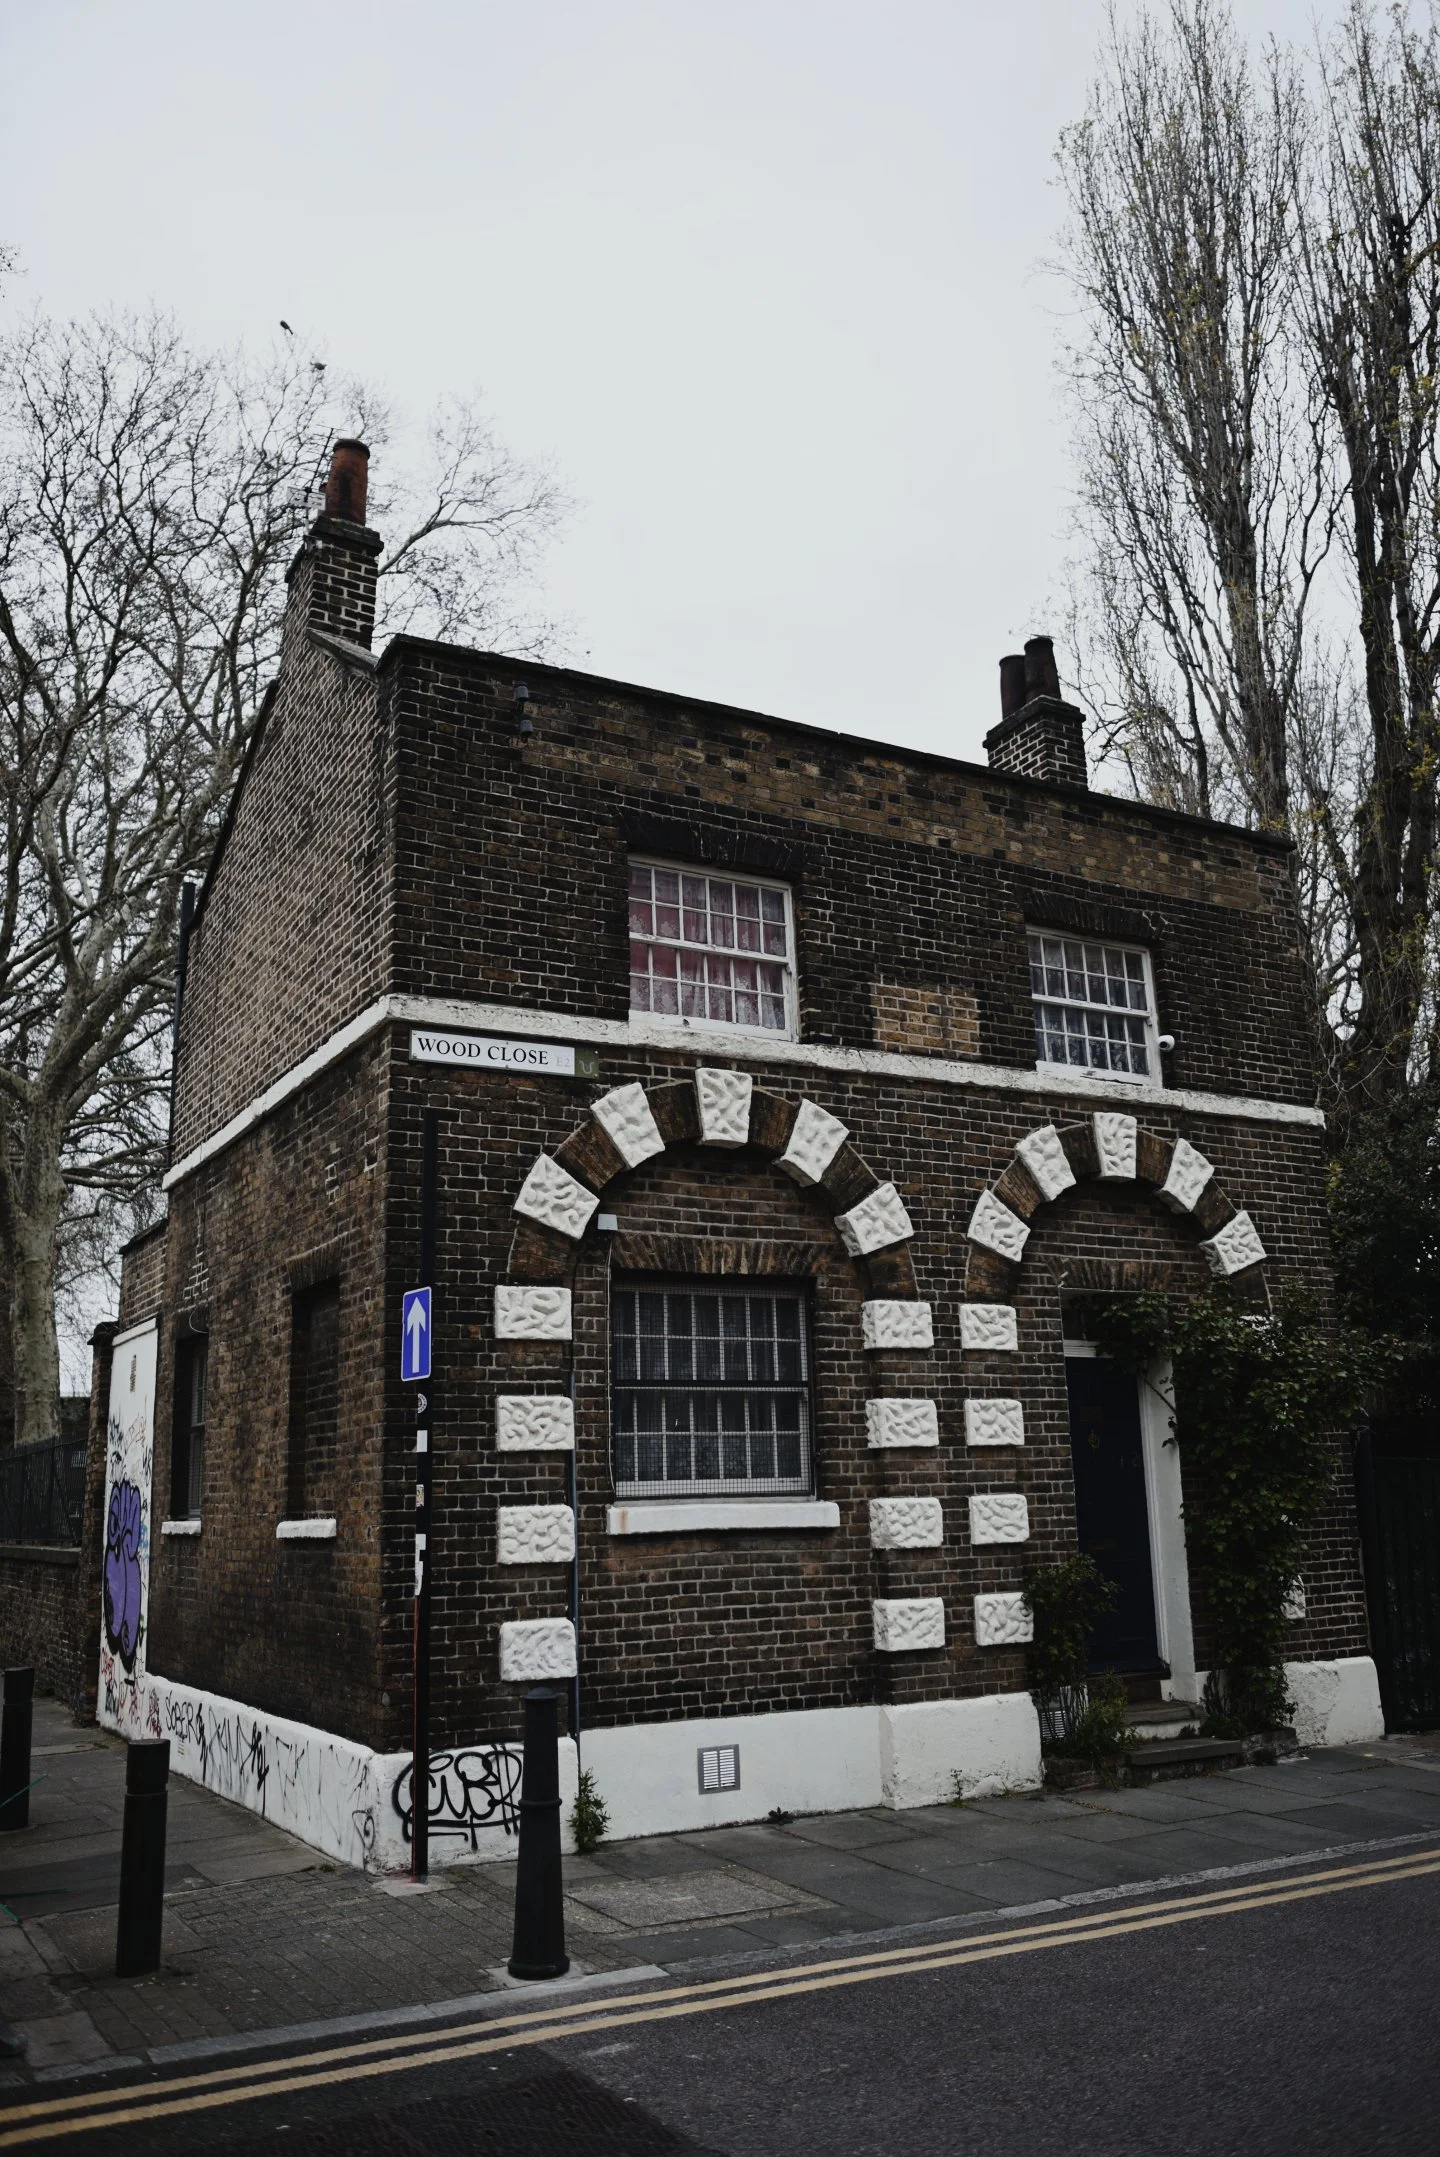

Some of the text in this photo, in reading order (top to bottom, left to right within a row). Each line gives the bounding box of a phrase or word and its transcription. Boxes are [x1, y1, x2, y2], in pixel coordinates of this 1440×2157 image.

[418, 1037, 571, 1068] WOOD CLOSE E2
